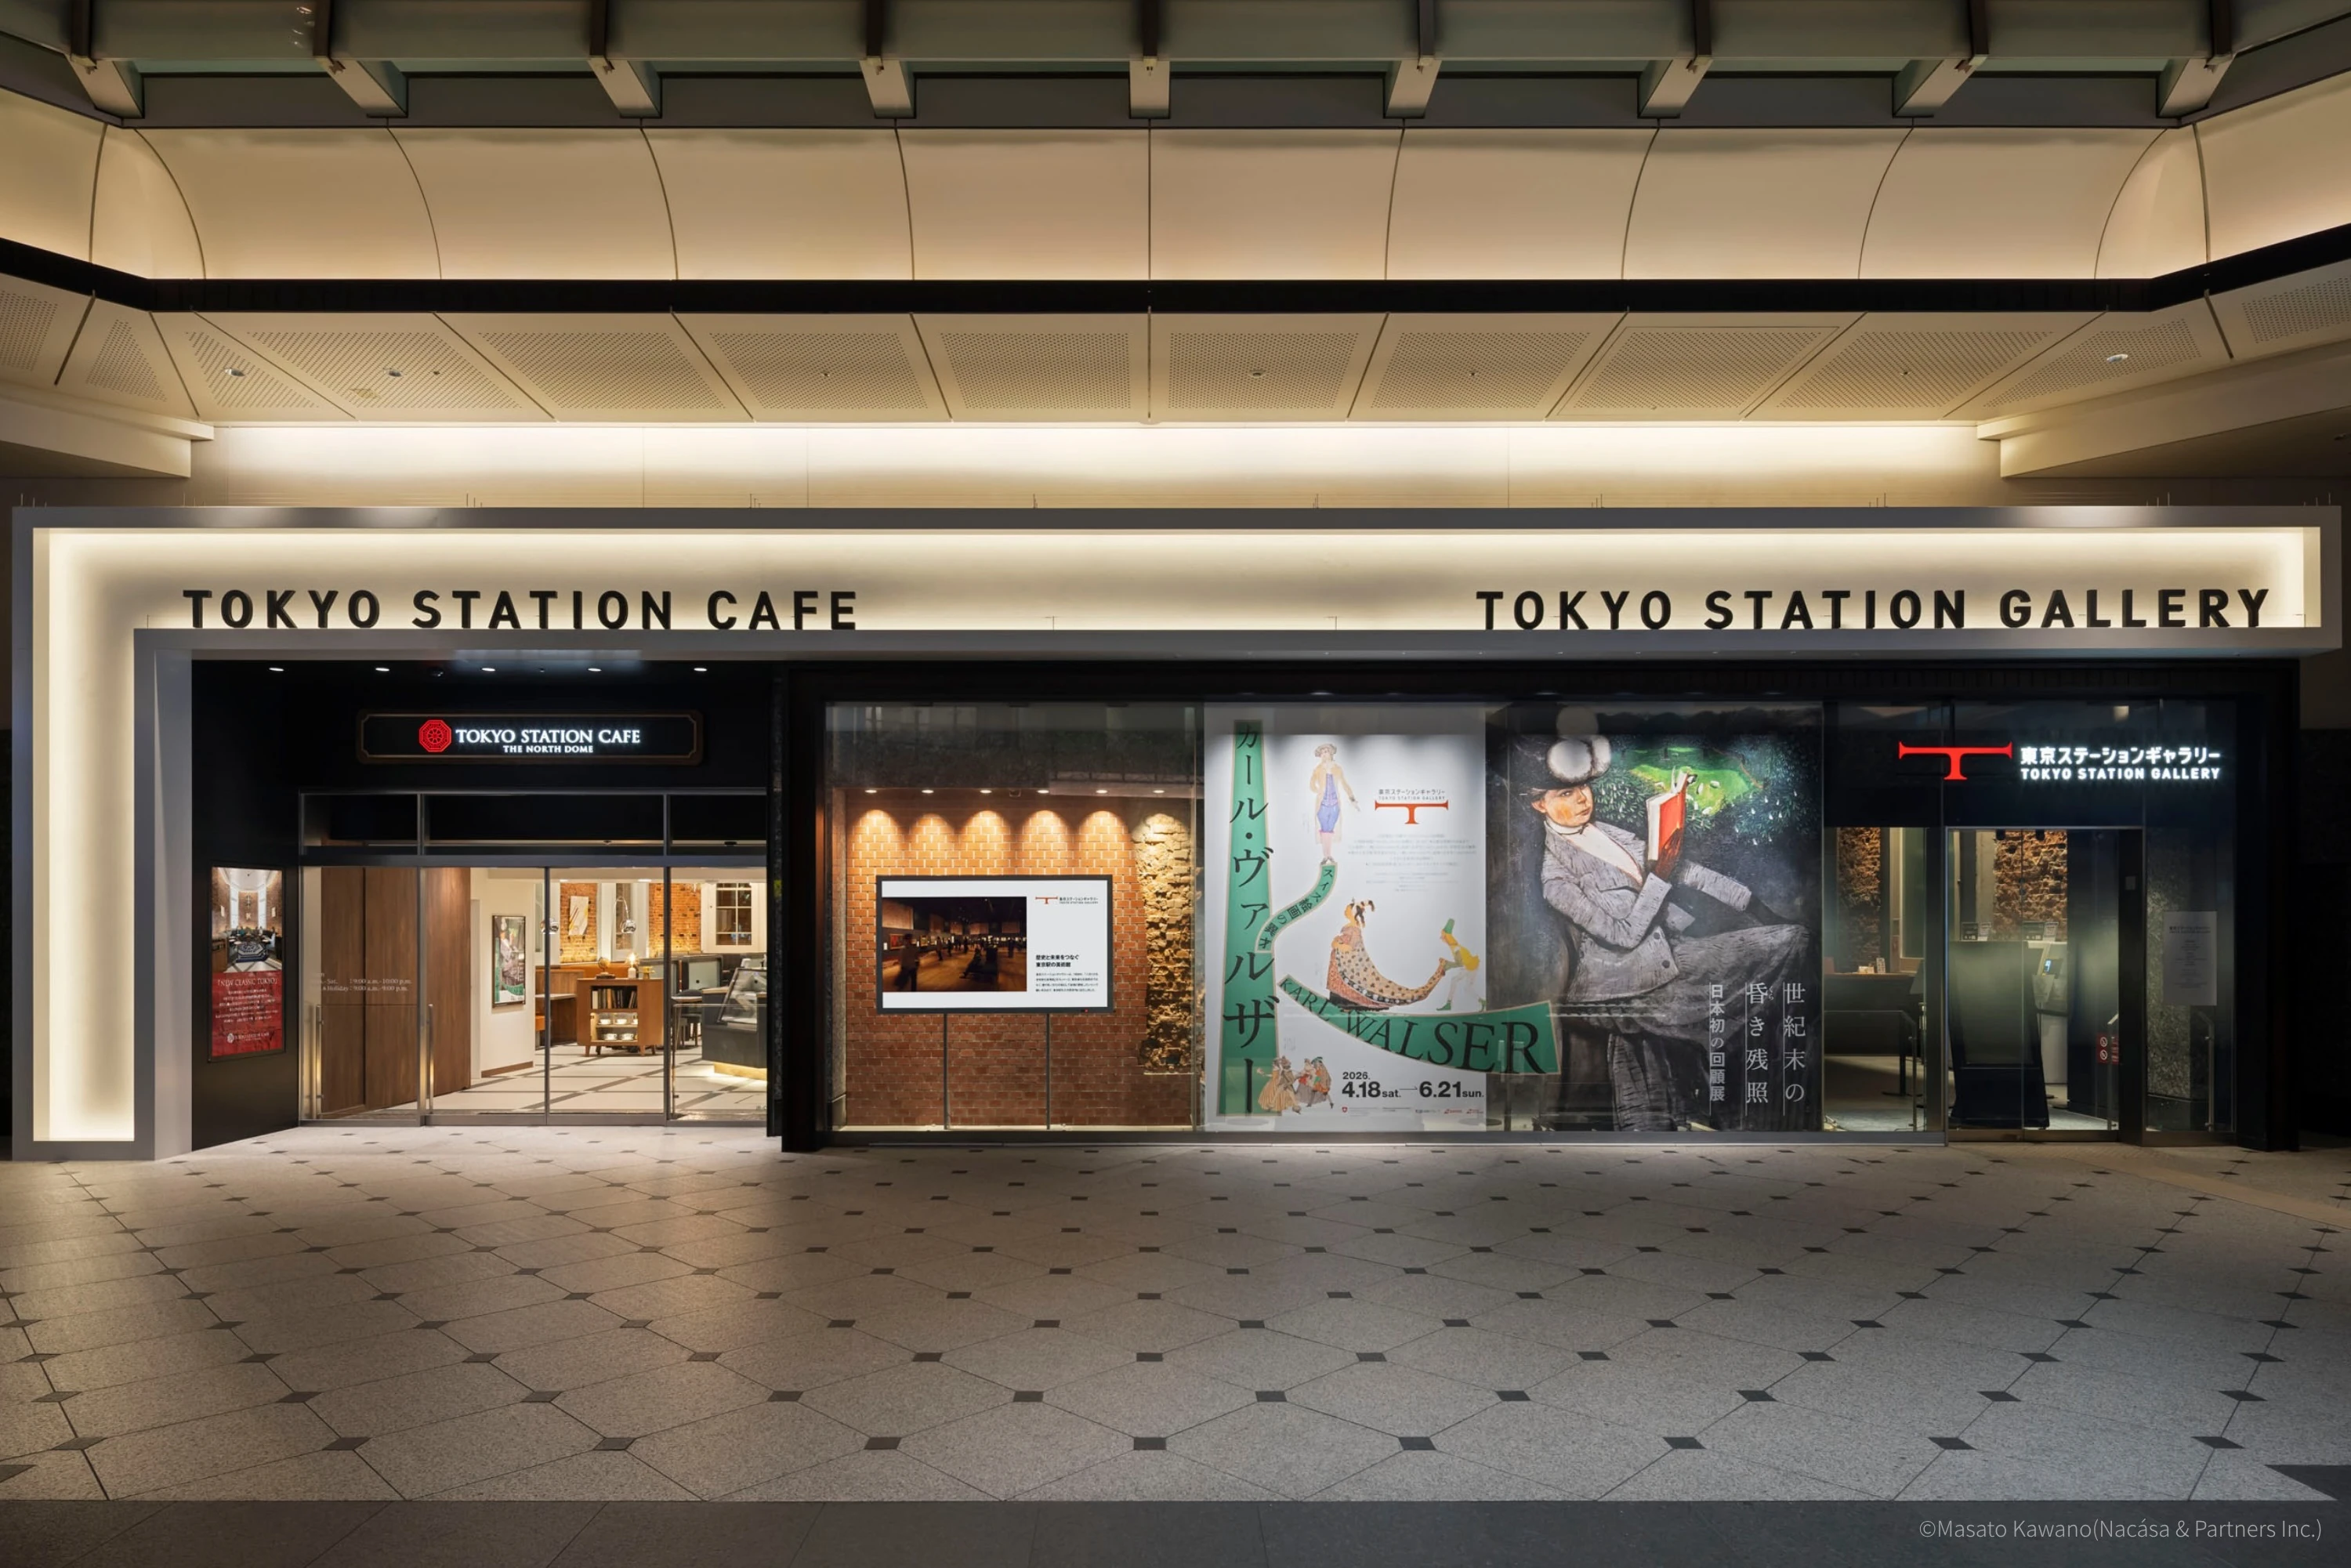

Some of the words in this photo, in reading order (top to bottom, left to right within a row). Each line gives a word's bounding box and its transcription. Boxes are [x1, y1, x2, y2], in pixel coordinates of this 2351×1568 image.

[183, 589, 380, 628] TOKYO
[411, 589, 671, 629] STATION
[707, 590, 856, 629] CAFE
[1476, 590, 1672, 629] TOKYO
[1704, 589, 1965, 629] STATION
[2000, 588, 2269, 628] GALLERY
[455, 730, 516, 744] TOKYO
[520, 730, 593, 744] STATION
[598, 730, 640, 744] CAFE
[2020, 747, 2221, 765] 東京ステーションギャラリー
[2021, 768, 2071, 780] TOKYO
[2078, 768, 2144, 780] STATION
[2151, 768, 2220, 780] GALLERY
[1223, 725, 1281, 1114] カール・ヴァルザー
[1259, 869, 1334, 949] スイス絵画の異才
[1279, 980, 1331, 1021] KARL
[1344, 1011, 1548, 1074] WALSER
[1710, 984, 1726, 1102] 日本初の回顧展
[1746, 982, 1769, 1103] 昏き残照
[1784, 983, 1806, 1103] 世紀末の
